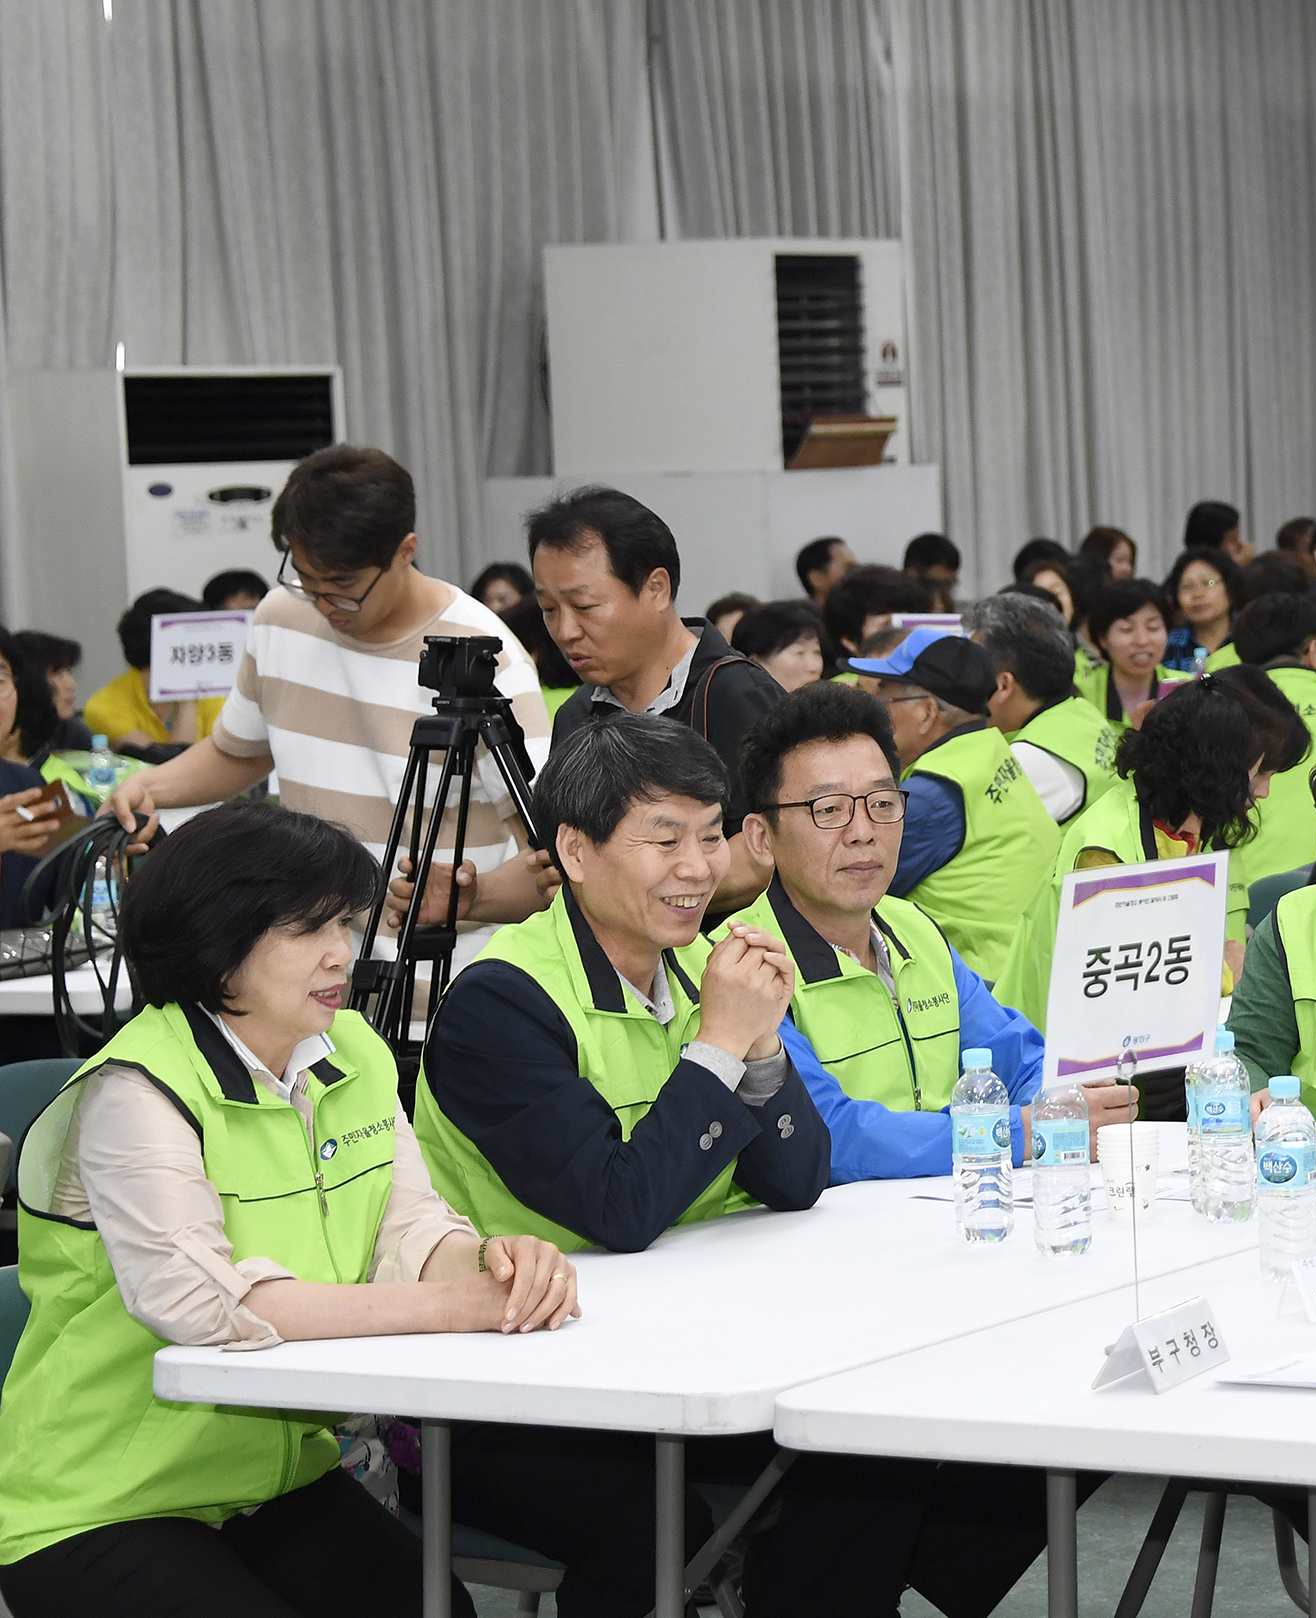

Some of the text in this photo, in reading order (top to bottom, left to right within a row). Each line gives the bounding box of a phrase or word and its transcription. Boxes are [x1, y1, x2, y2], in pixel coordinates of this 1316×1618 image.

[169, 641, 235, 667] 자양3동
[1082, 933, 1193, 999] 중곡2동
[340, 1116, 396, 1147] 주민자율청소봉사
[1262, 1160, 1293, 1174] 백산수
[1148, 1321, 1219, 1373] 부구청장
